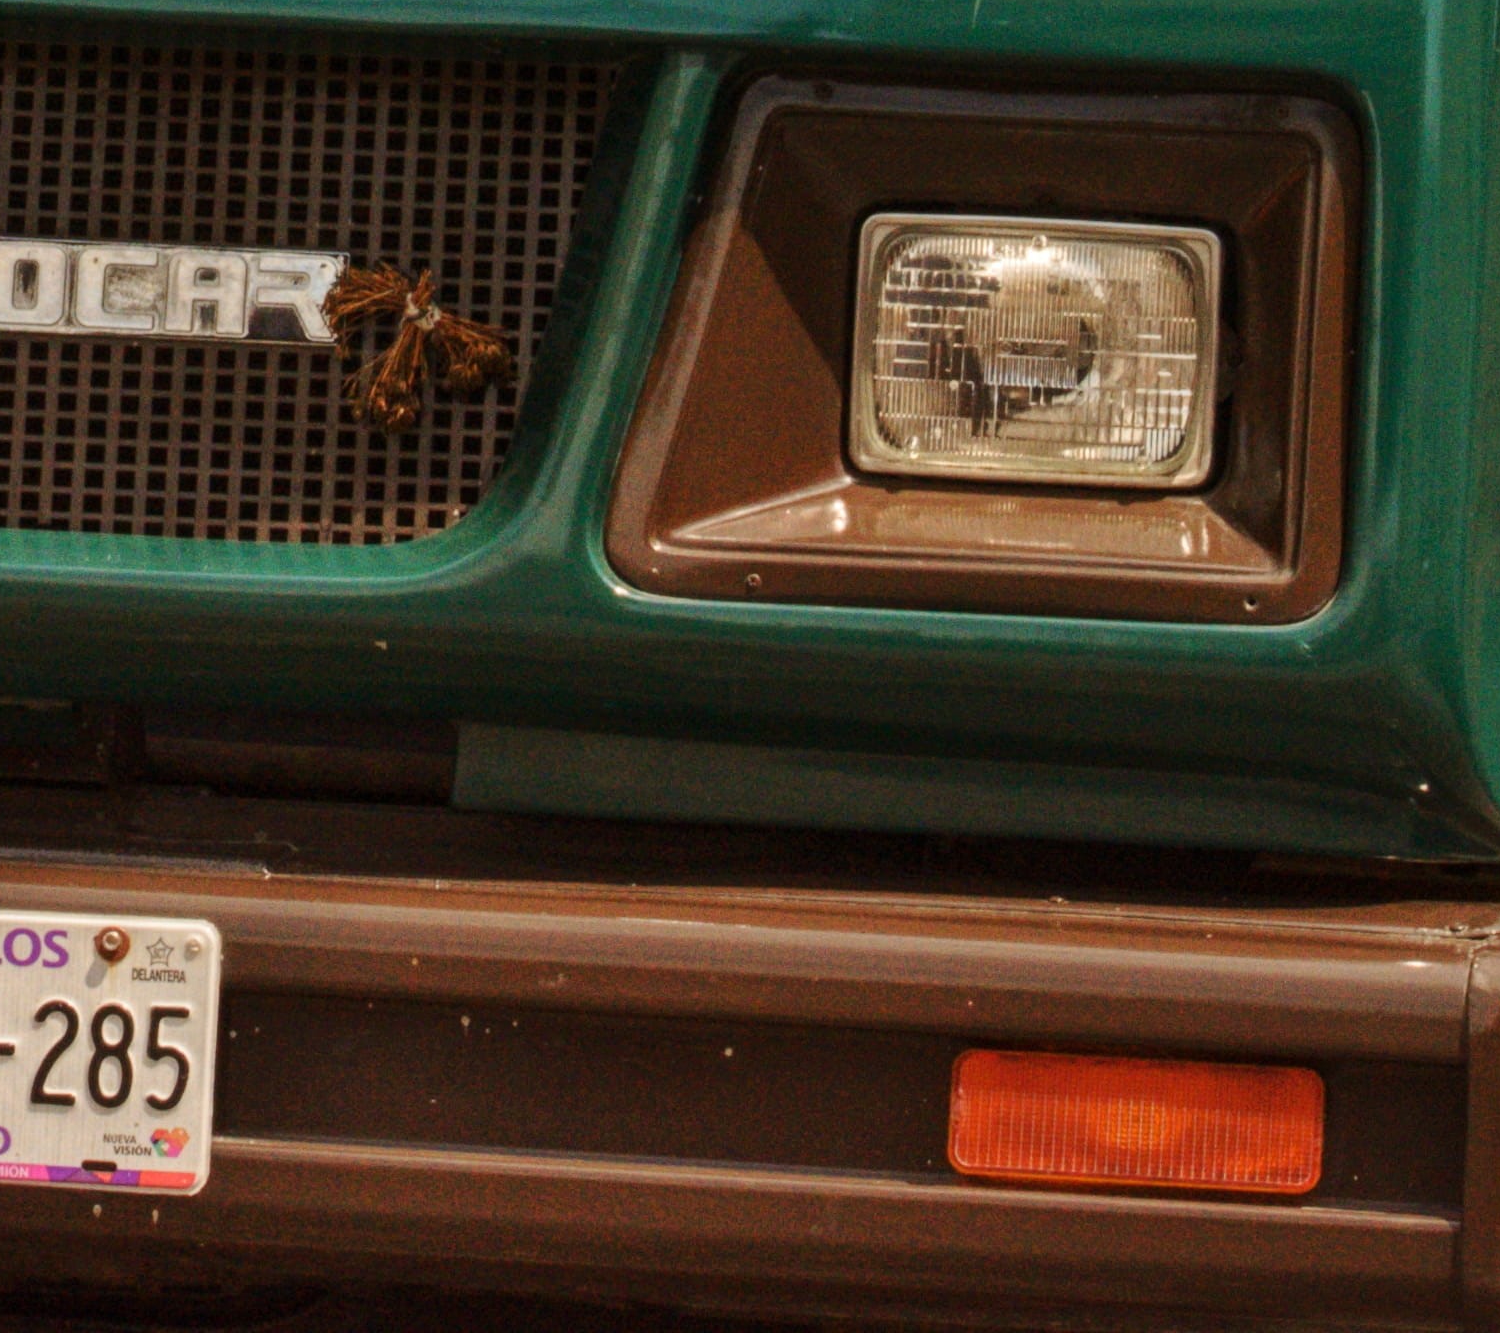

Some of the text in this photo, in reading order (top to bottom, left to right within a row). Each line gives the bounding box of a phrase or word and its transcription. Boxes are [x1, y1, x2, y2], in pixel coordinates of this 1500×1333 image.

[131, 967, 188, 984] DELANTERA
[102, 1133, 137, 1145] NUEVA
[113, 1141, 152, 1157] VISIÓN
